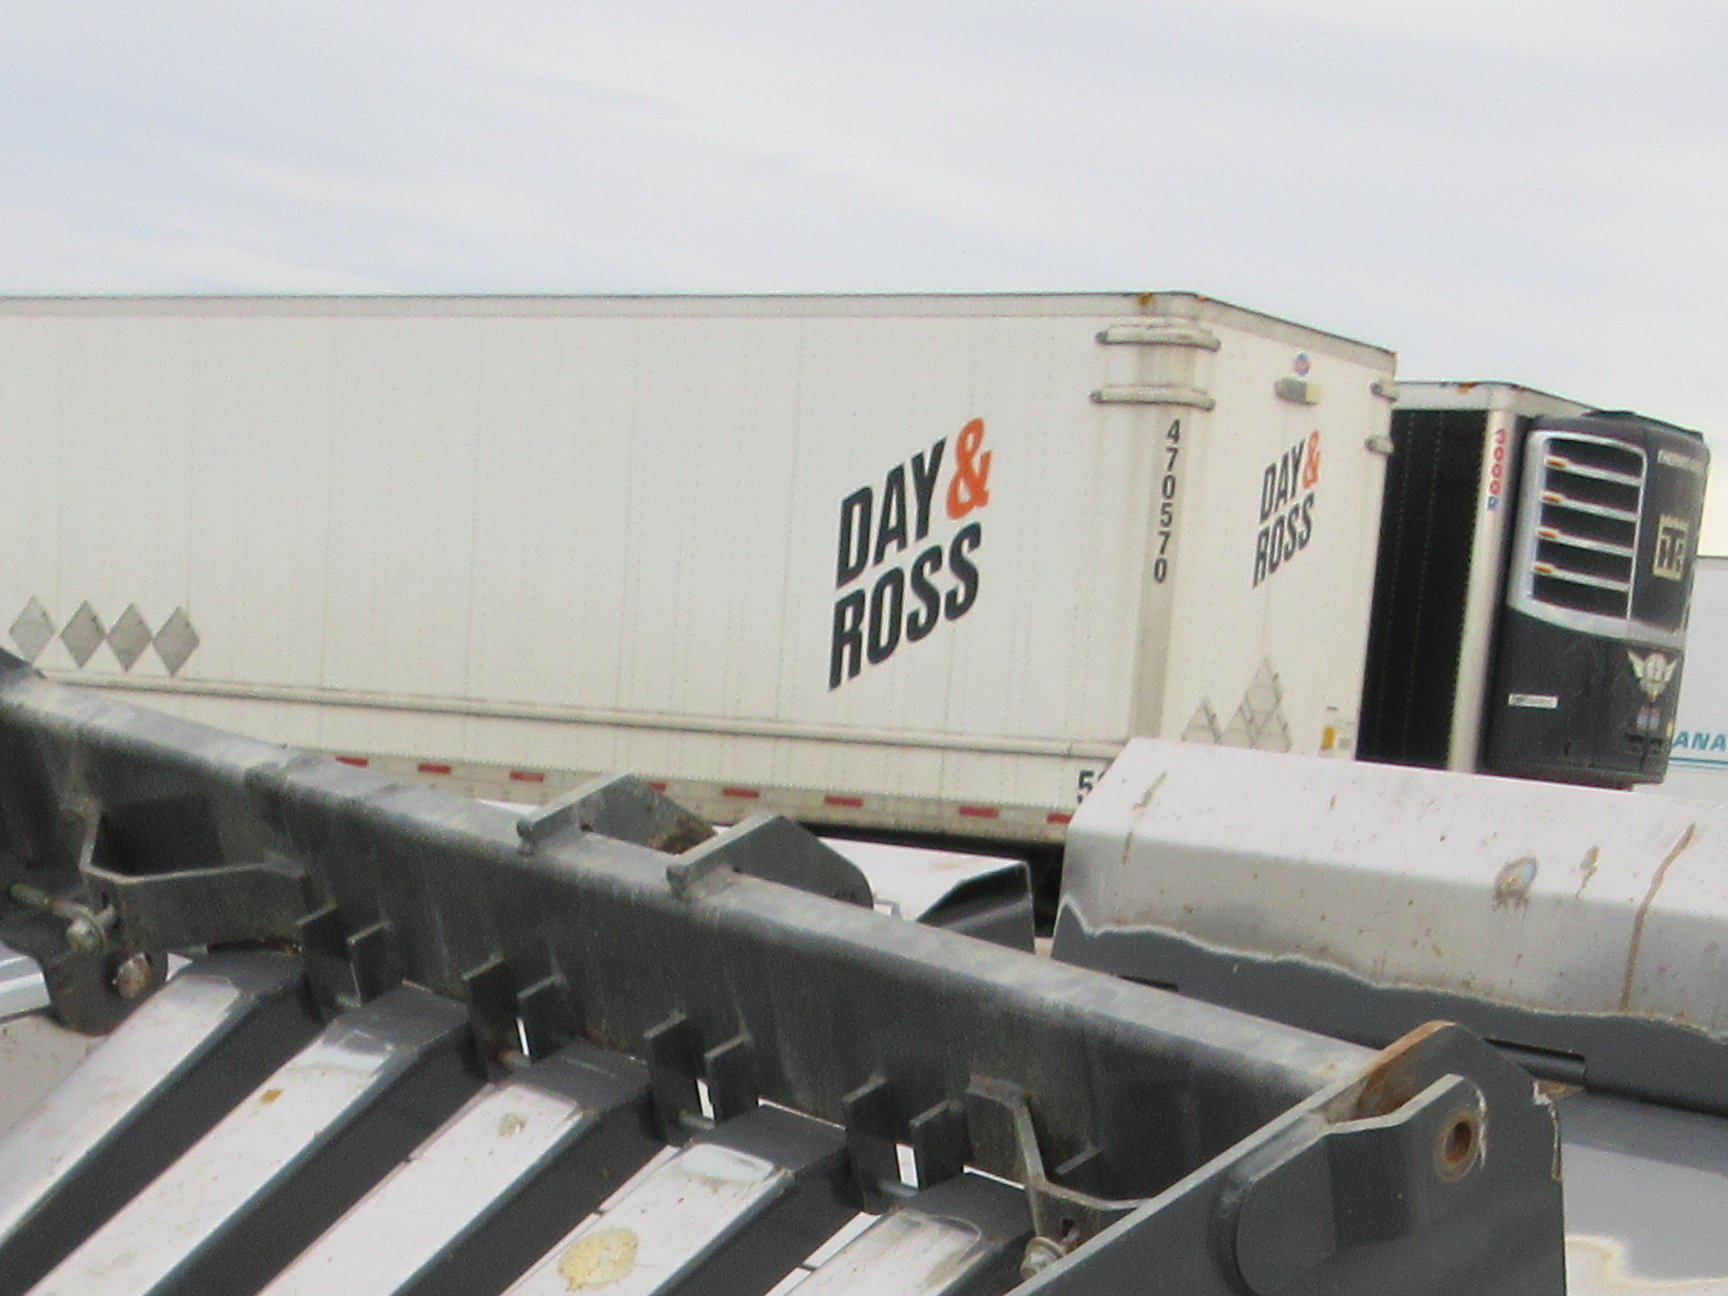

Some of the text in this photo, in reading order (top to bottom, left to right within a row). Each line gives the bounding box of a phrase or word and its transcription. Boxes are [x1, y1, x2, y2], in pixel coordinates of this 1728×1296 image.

[1154, 419, 1180, 583] 470570
[1252, 491, 1314, 590] ROSS
[829, 521, 981, 692] ROSS
